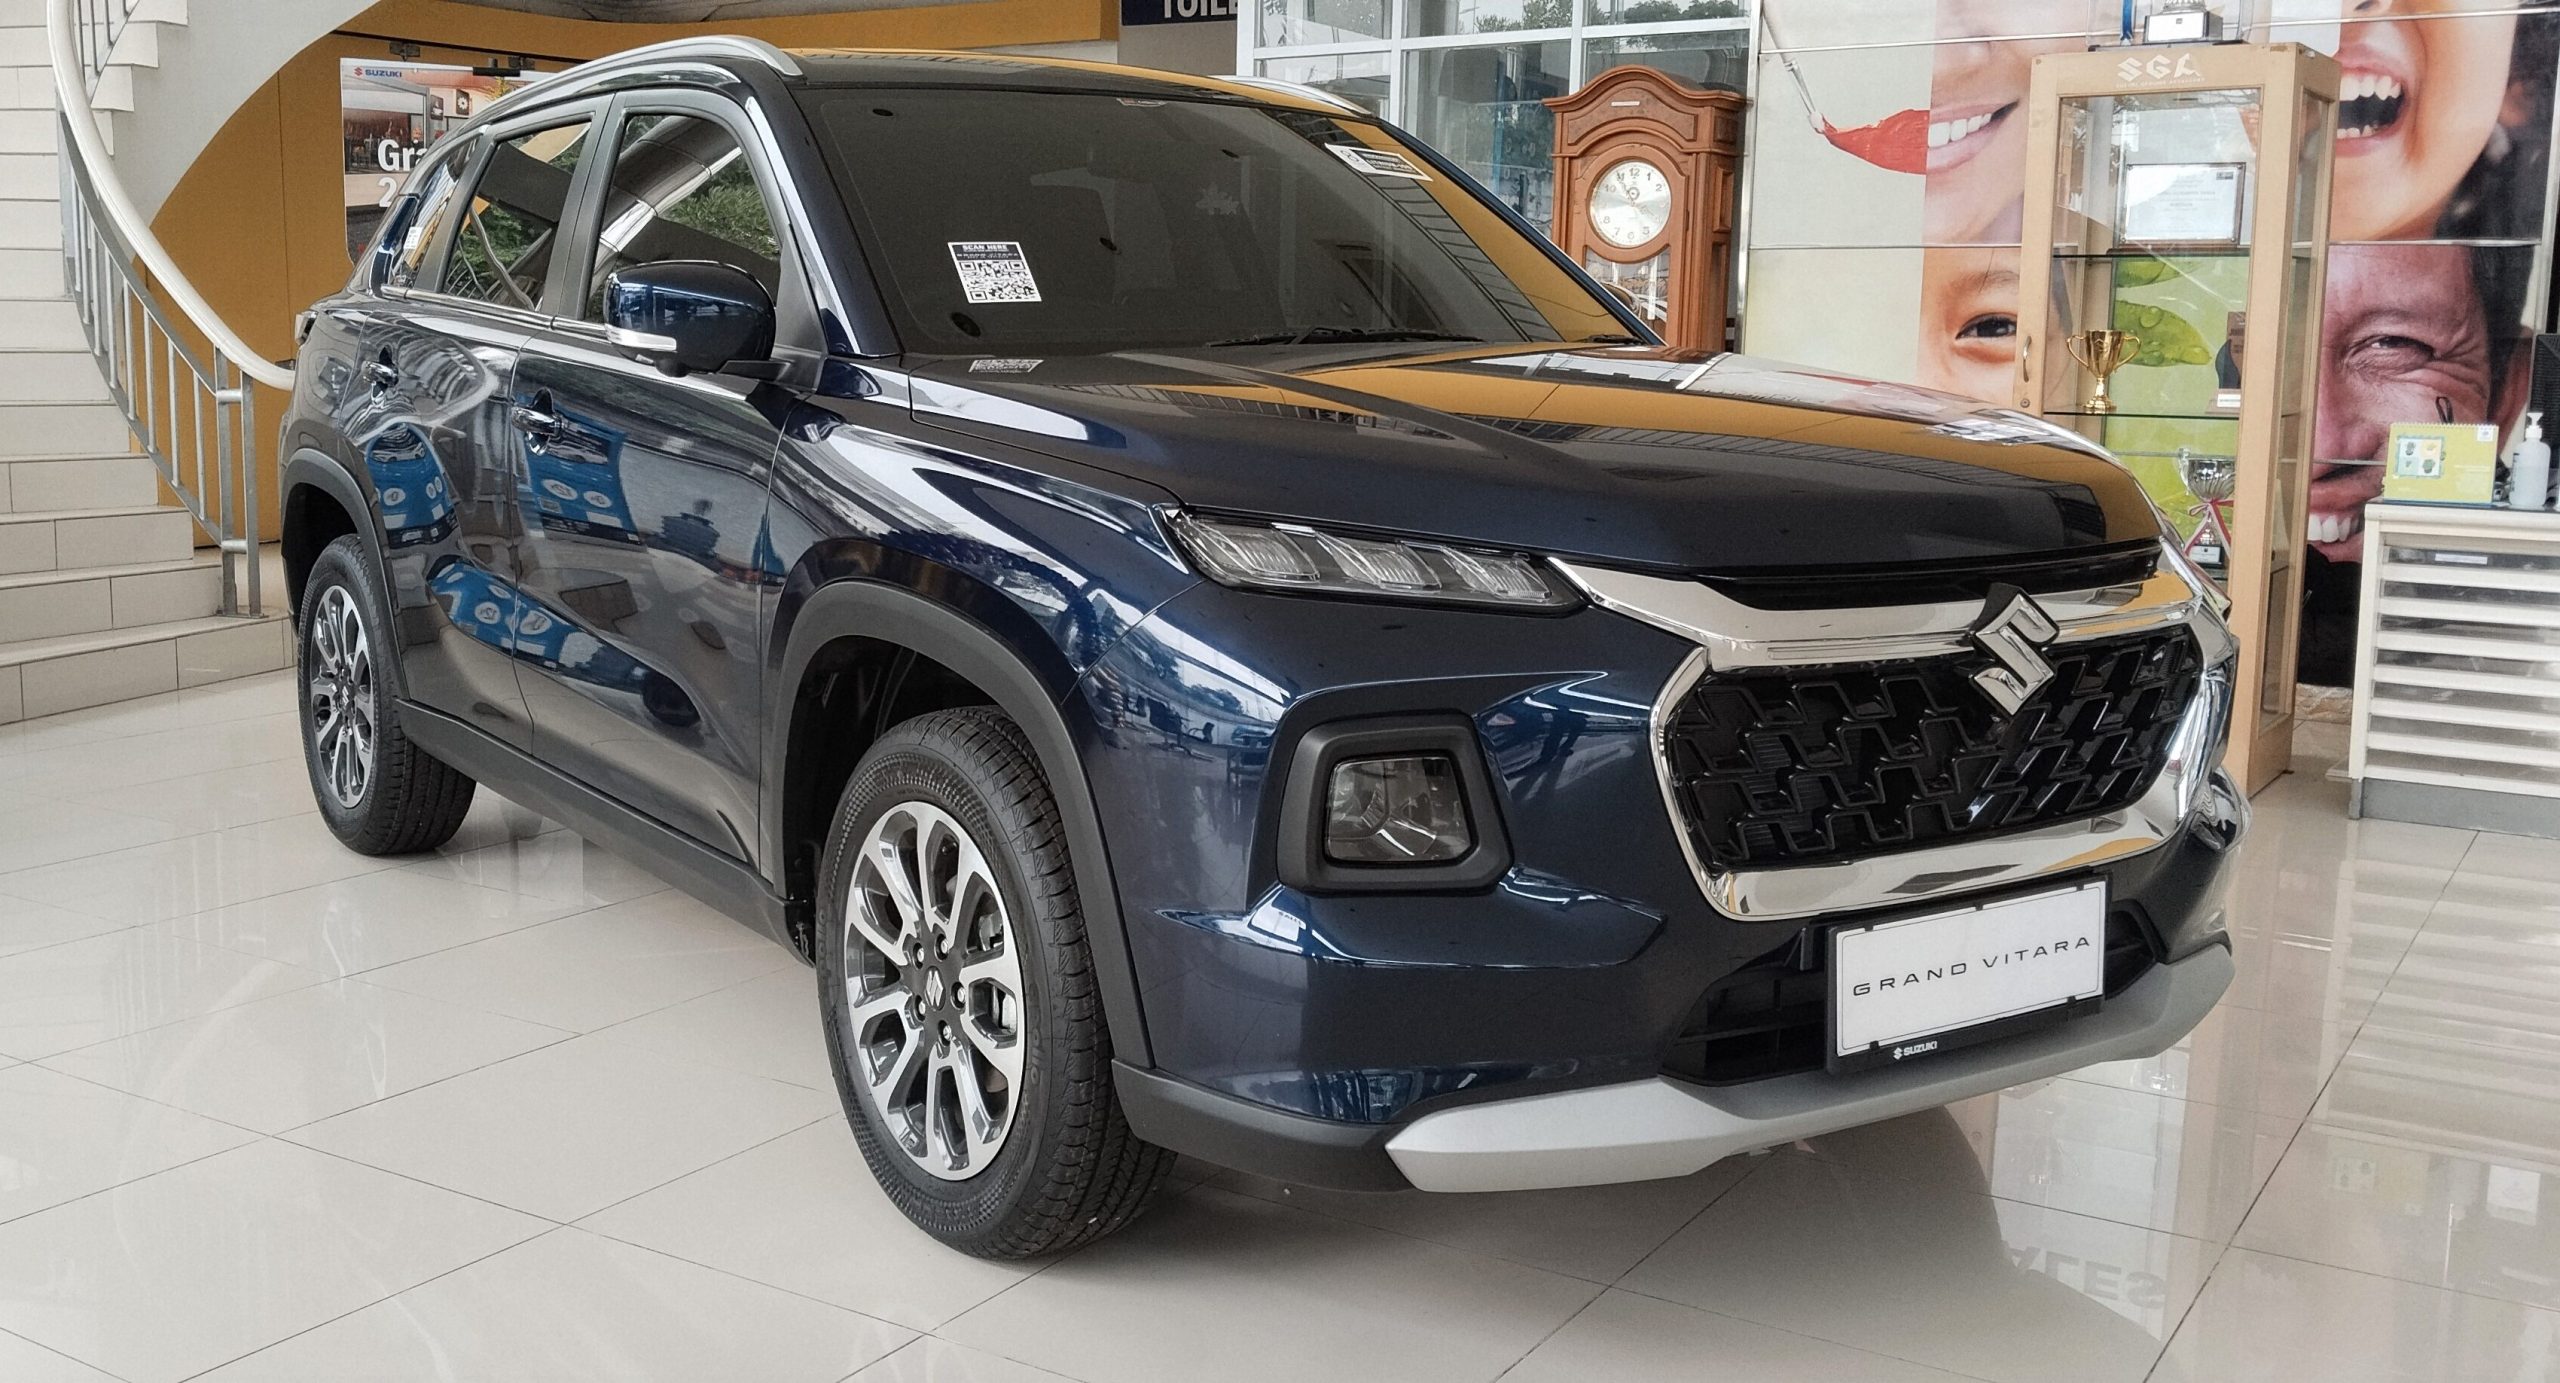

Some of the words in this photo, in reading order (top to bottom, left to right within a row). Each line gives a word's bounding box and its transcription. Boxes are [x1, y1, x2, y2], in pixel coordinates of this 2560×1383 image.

[1164, 0, 1238, 18] OIL
[365, 69, 402, 78] SUZUKI
[1629, 168, 1641, 177] 12
[1647, 172, 1652, 181] 1
[1604, 184, 1617, 193] 10
[1655, 183, 1663, 192] 2
[1603, 216, 1610, 224] 8
[1852, 962, 1968, 996] GRAND
[1982, 936, 2090, 969] VITARA
[1903, 1040, 1938, 1056] SUZUKI
